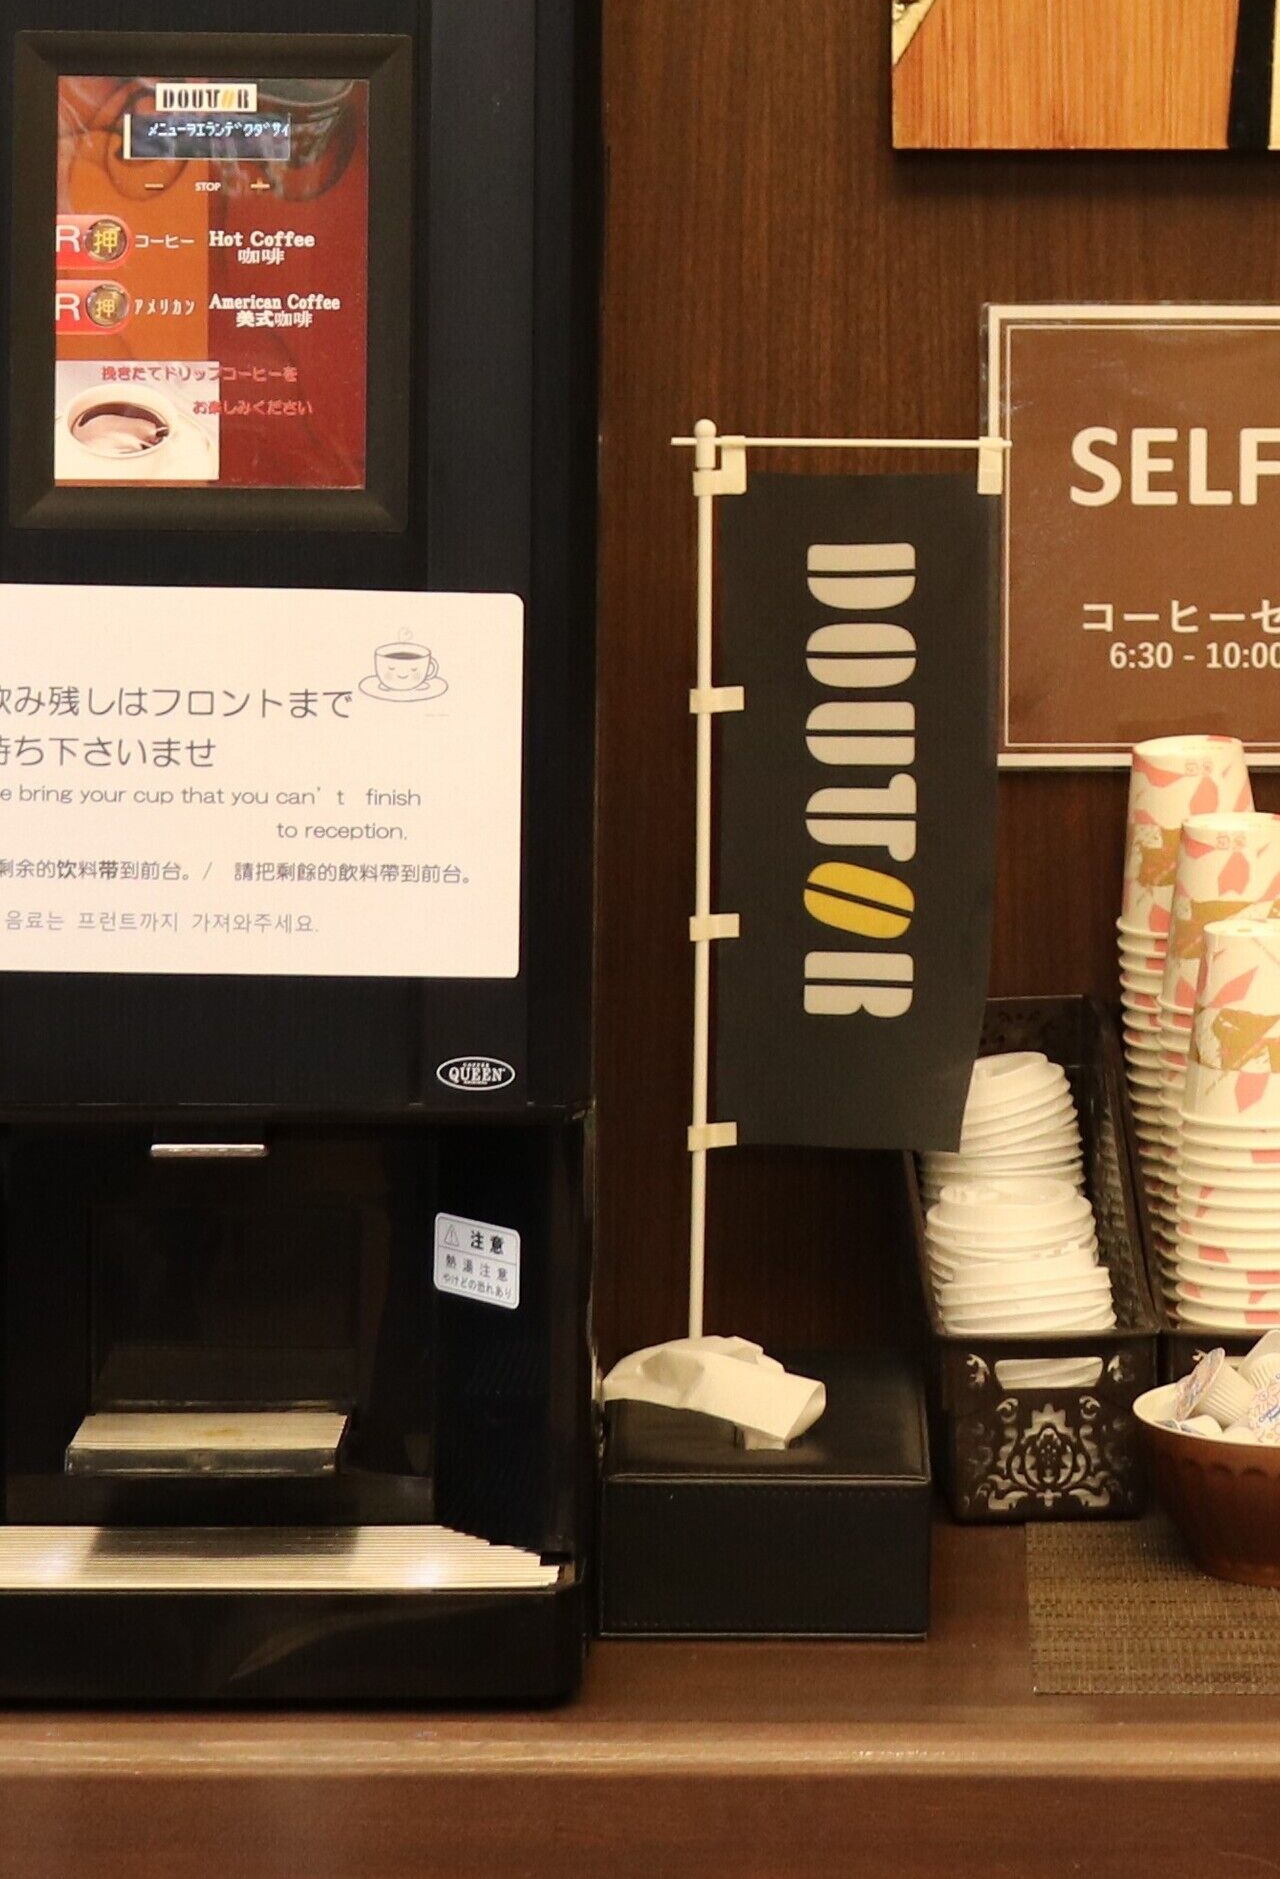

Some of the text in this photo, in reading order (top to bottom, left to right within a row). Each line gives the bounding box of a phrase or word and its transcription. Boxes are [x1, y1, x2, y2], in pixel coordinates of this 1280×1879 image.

[162, 89, 249, 108] DOUTOR
[195, 182, 221, 191] STOP
[135, 235, 195, 248] コーヒー
[209, 230, 315, 248] Hot Coffee
[134, 298, 195, 316] アメリカン
[209, 293, 341, 310] American Coffee
[1109, 641, 1173, 671] 6:30
[803, 542, 917, 1018] DOUTOR
[19, 784, 73, 804] bring
[80, 788, 126, 804] your
[133, 789, 174, 805] cup
[182, 787, 225, 805] that
[231, 790, 269, 806] you
[366, 787, 421, 806] finish
[277, 822, 407, 841] to reception.
[5, 910, 64, 931] 음료는
[78, 911, 178, 932] 프런트까지
[448, 1066, 502, 1084] QUEEN
[470, 1229, 504, 1255] 注意
